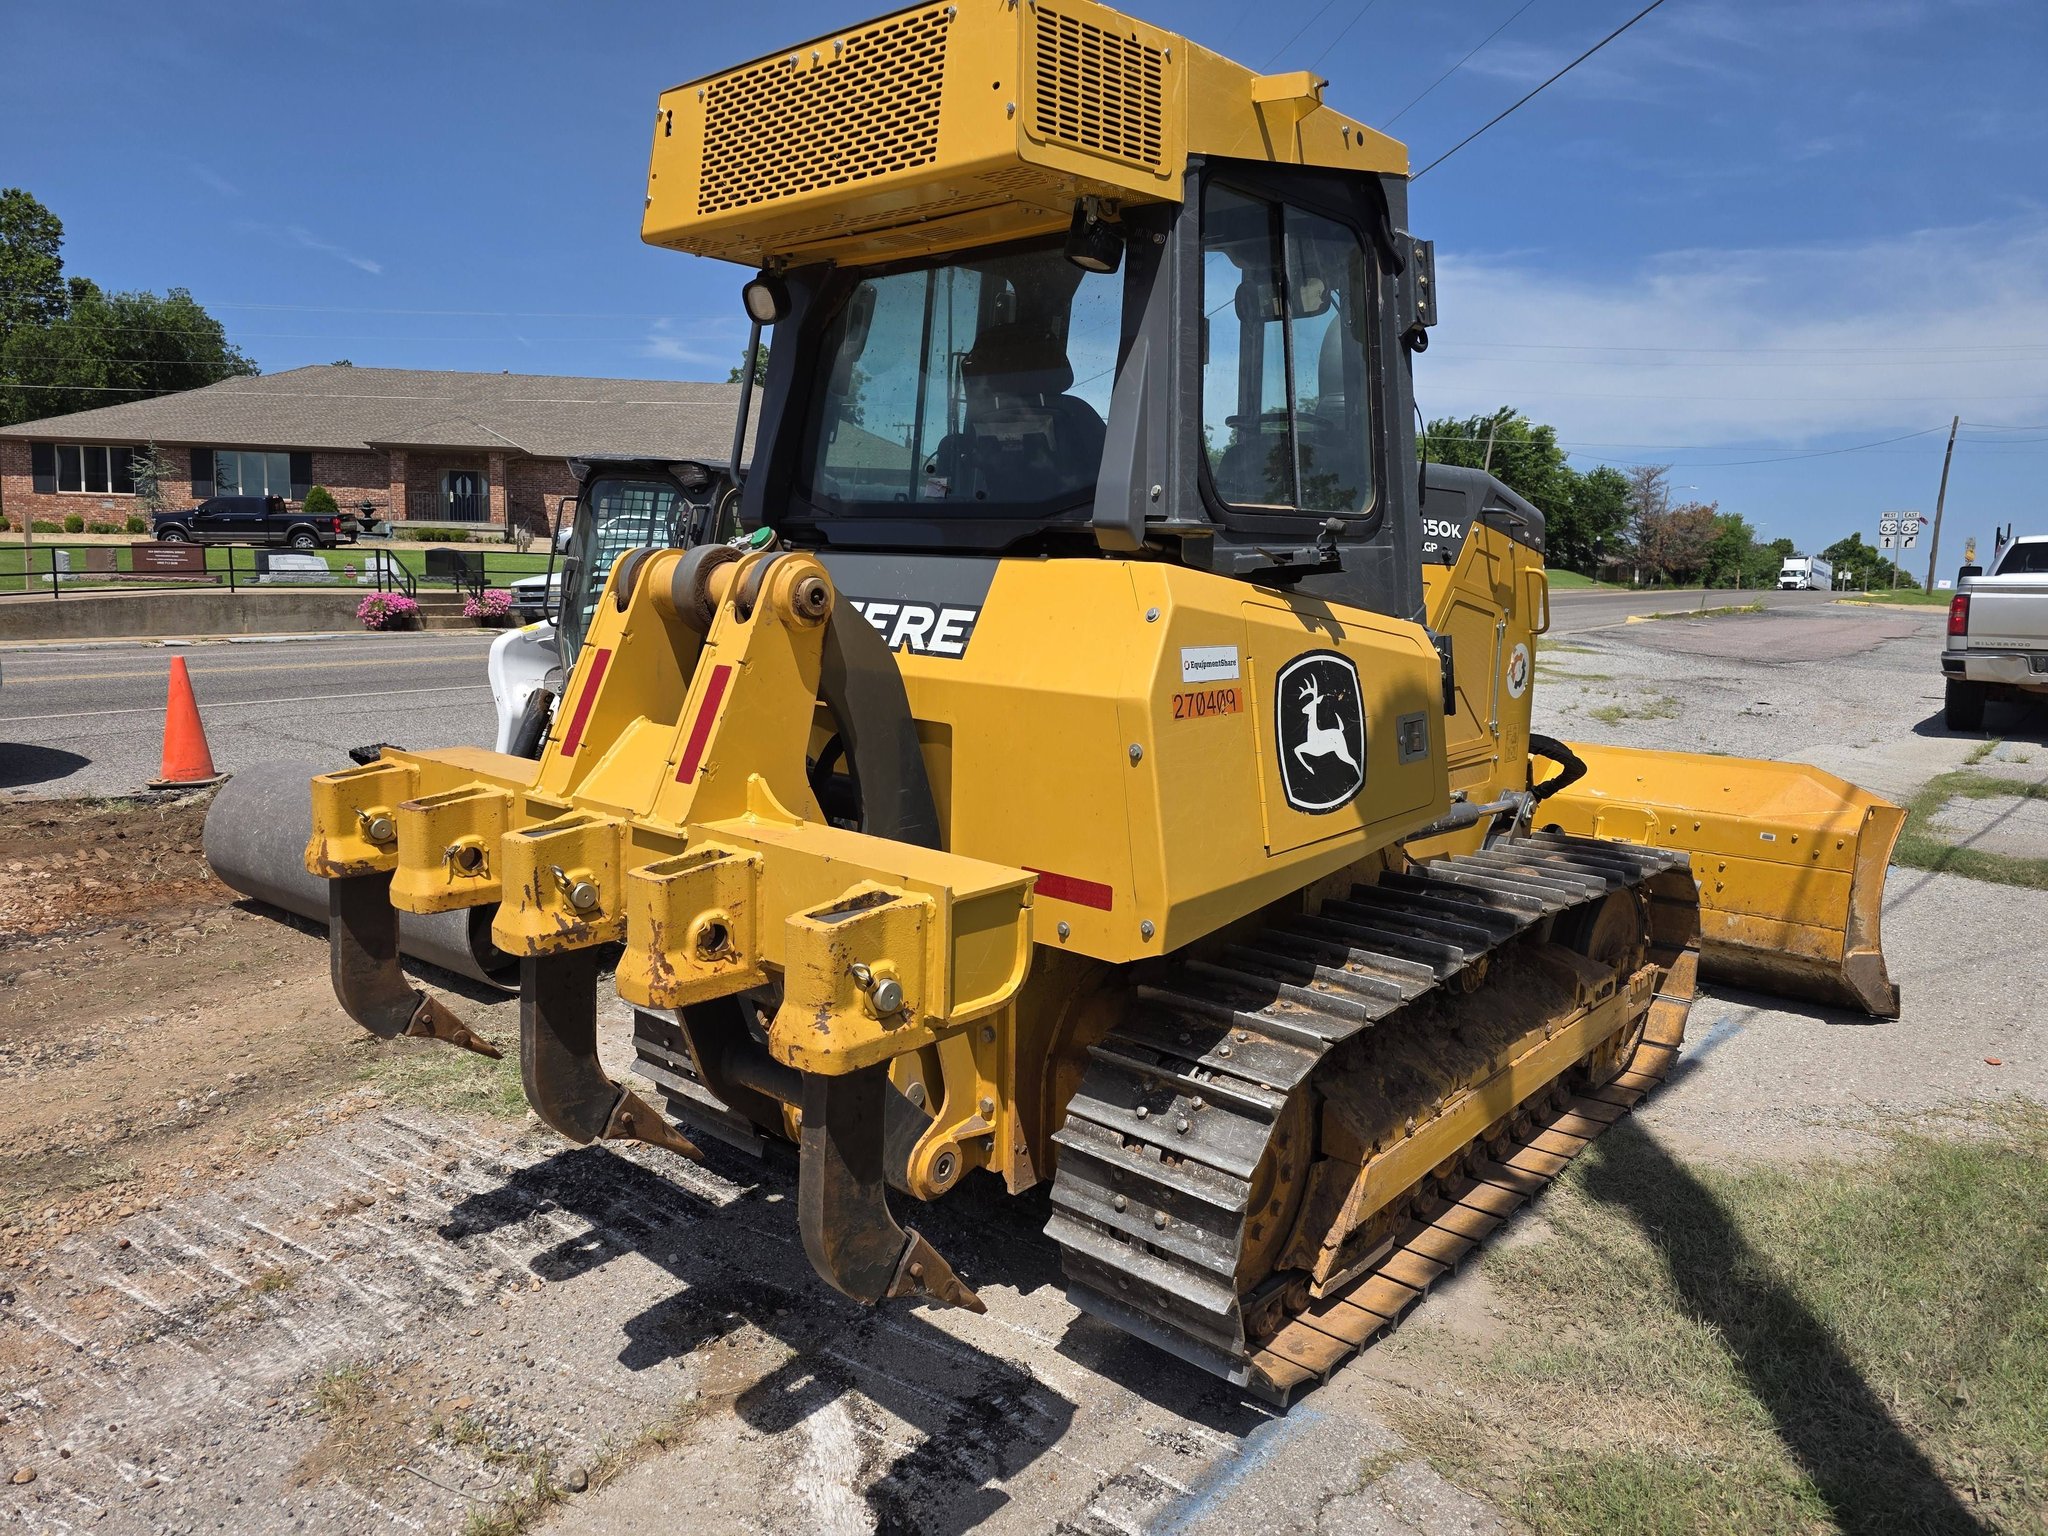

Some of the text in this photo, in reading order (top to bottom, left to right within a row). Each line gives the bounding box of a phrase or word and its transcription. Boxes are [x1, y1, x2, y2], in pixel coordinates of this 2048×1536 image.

[1881, 523, 1896, 532] 62
[1902, 523, 1917, 532] 62
[1422, 541, 1438, 552] GP
[850, 601, 977, 654] ERE
[1190, 659, 1237, 670] EquipmentShare
[1173, 688, 1236, 719] 270409
